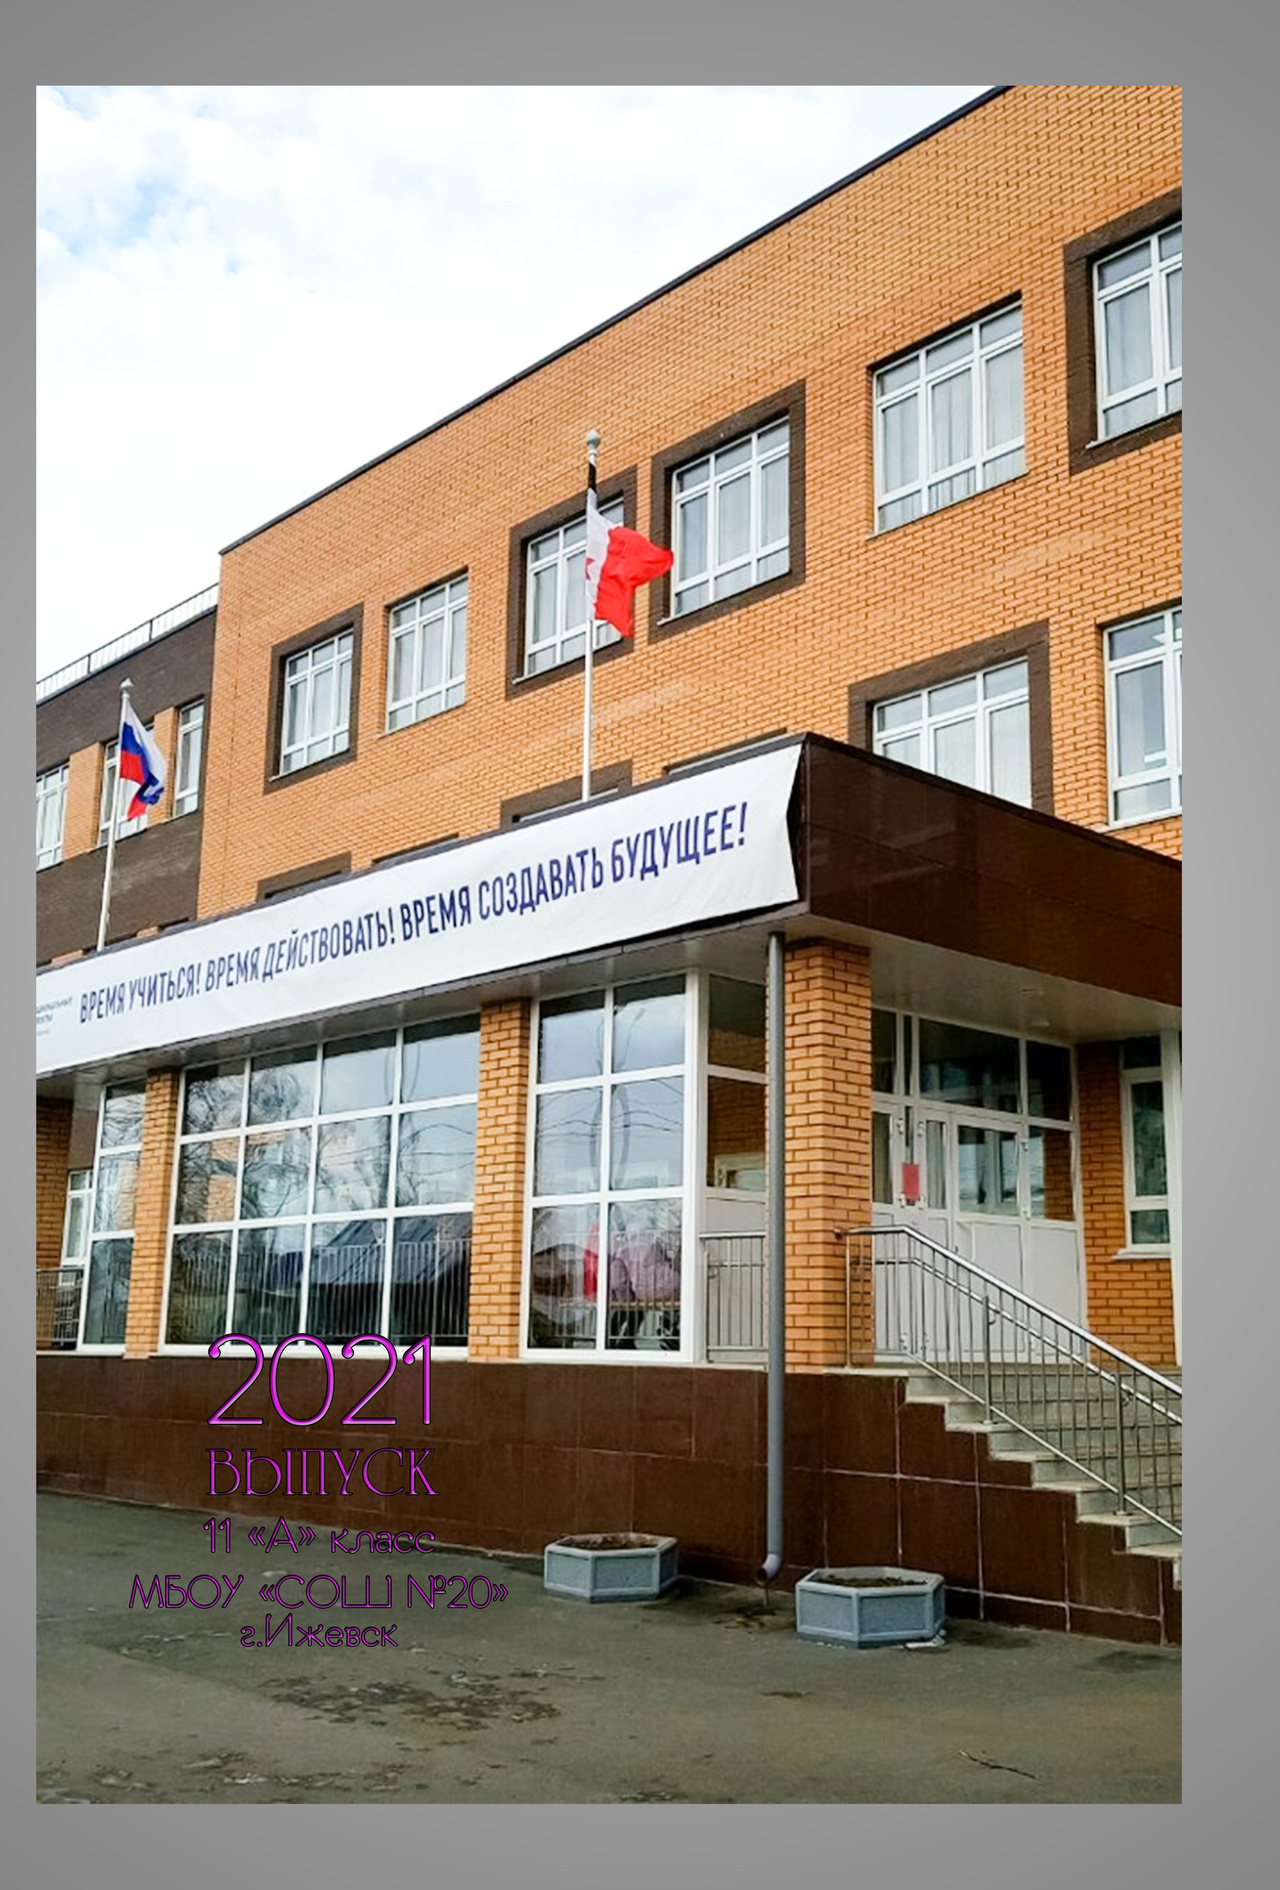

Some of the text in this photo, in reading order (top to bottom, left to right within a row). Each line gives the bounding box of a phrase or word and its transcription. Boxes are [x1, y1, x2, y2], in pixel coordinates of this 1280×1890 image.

[79, 802, 748, 1024] ВРЕМЯ УЧИТЬСЯ! ВРЕМЯ ДЕЙСТВОВАТЬ! ВРЕМЯ СОЗДАВАТЬ БУДУЩЕЕ!
